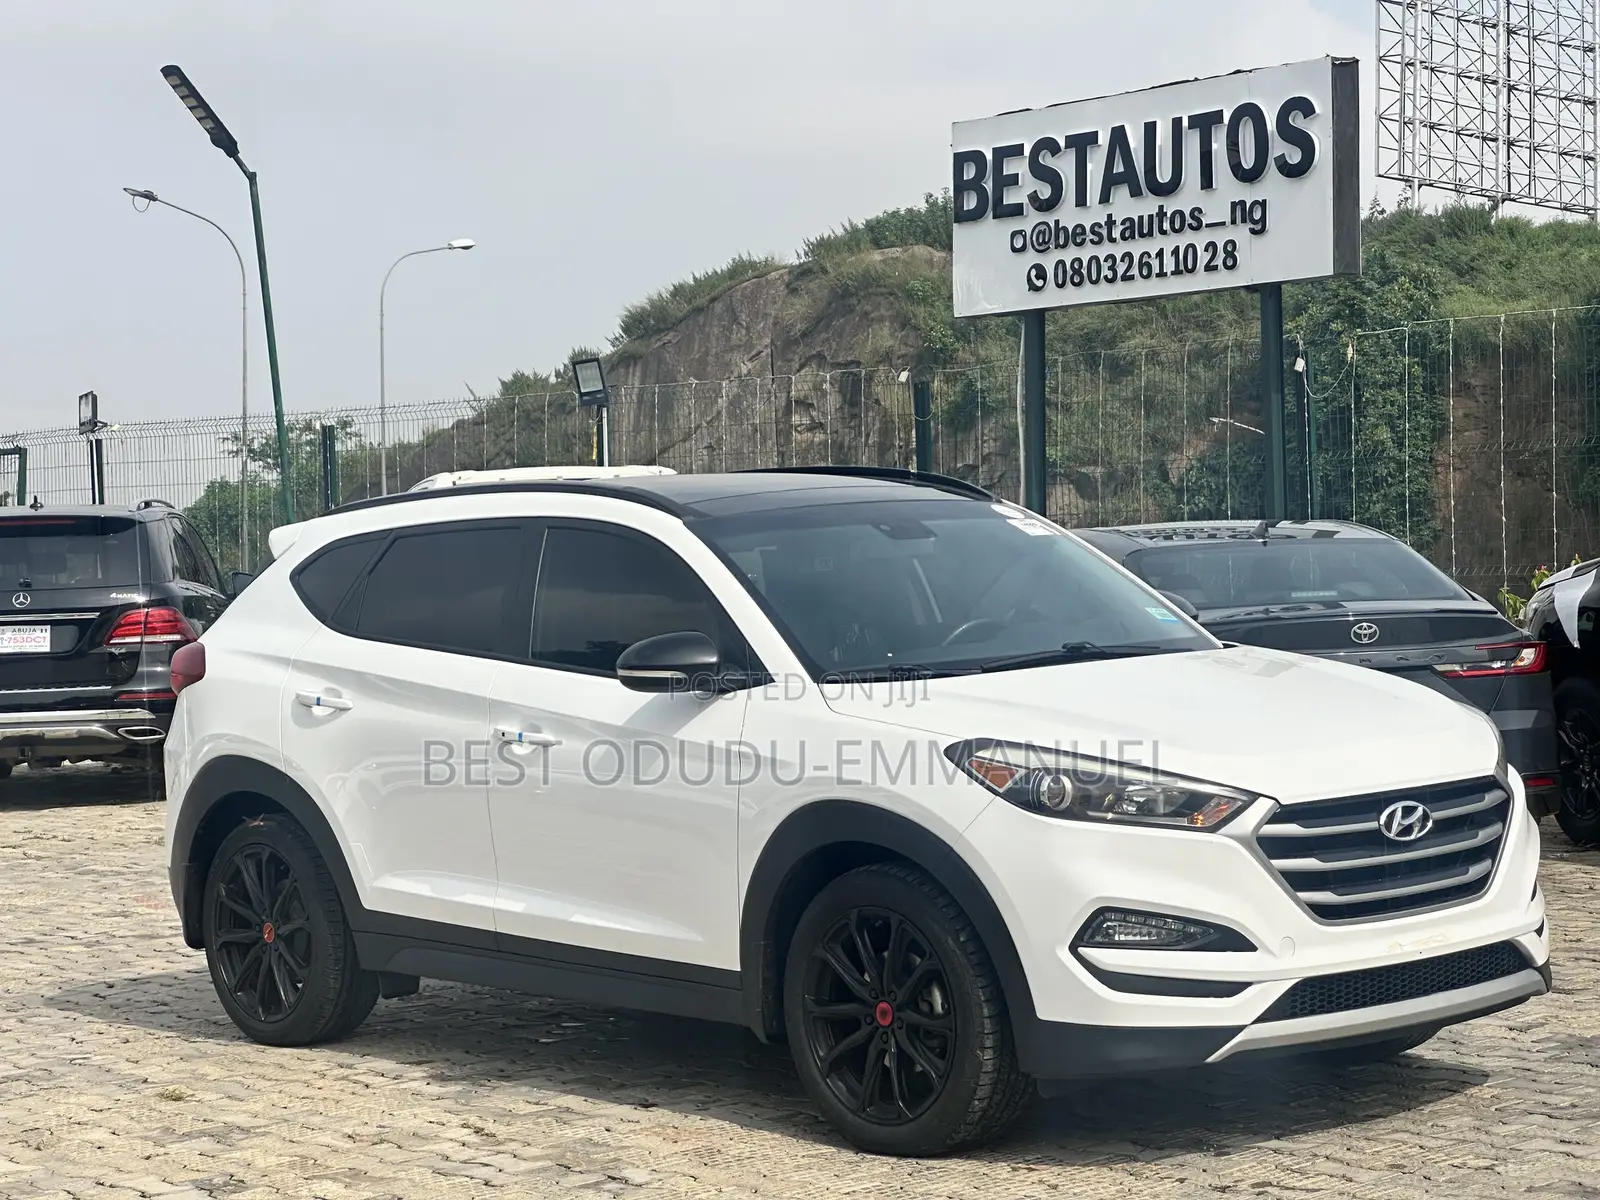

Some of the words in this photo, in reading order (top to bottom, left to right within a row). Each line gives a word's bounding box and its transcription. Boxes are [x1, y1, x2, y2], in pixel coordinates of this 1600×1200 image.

[953, 95, 1318, 223] BESTAUTOS
[1030, 198, 1268, 254] @bestautos_ng
[1053, 238, 1238, 289] 08032611028
